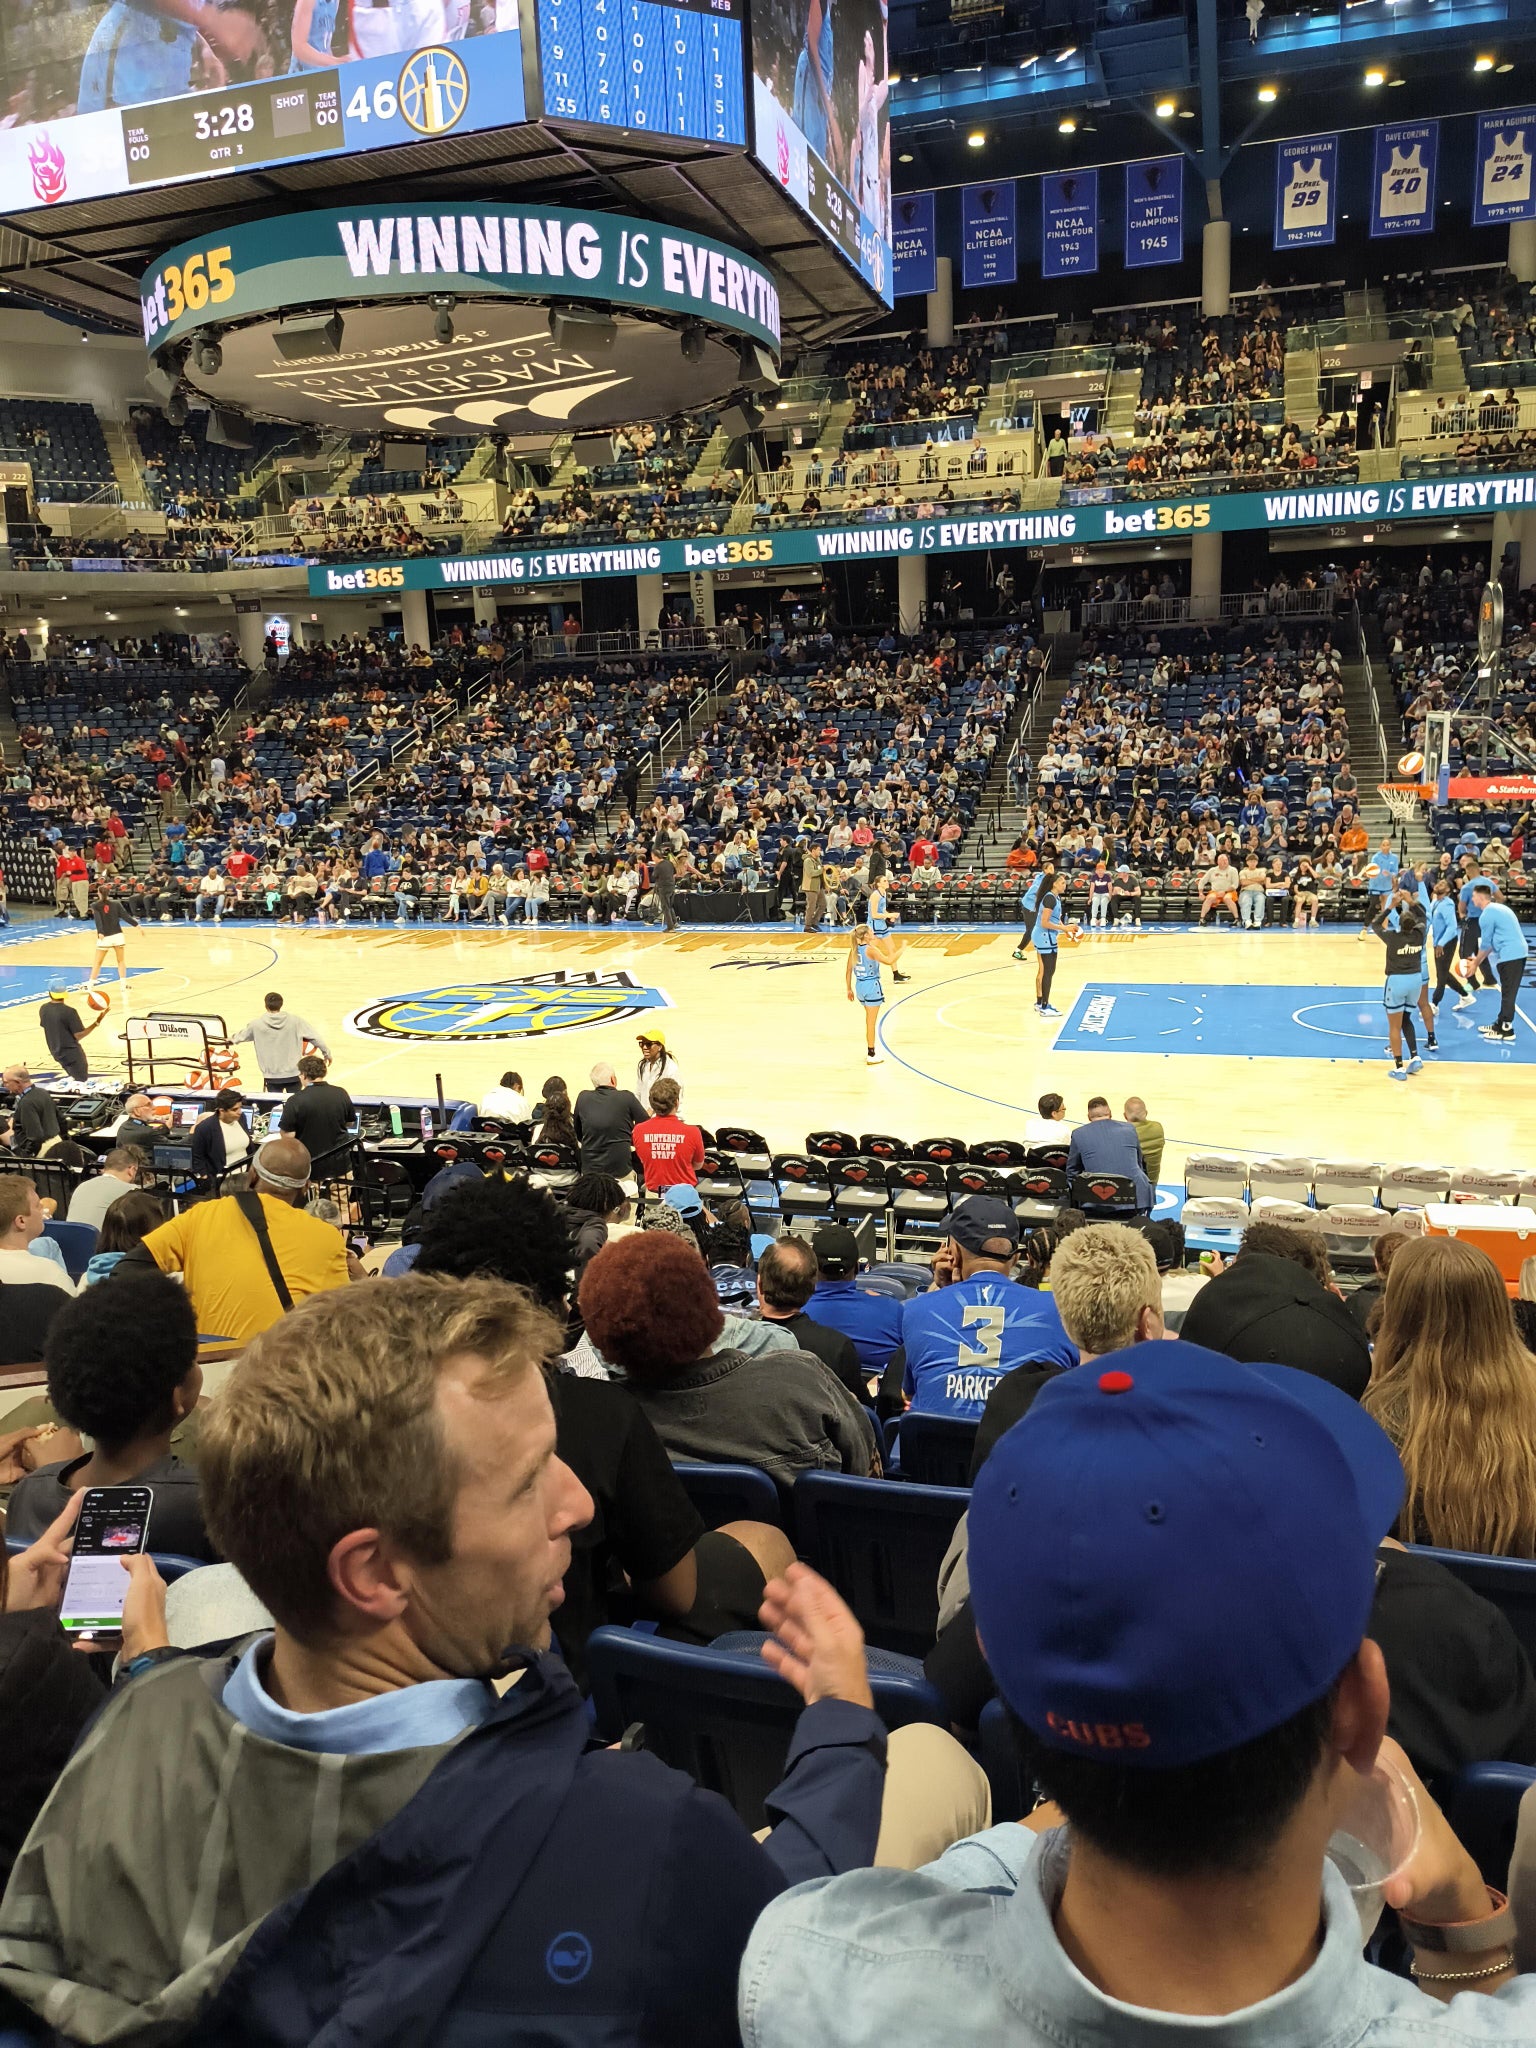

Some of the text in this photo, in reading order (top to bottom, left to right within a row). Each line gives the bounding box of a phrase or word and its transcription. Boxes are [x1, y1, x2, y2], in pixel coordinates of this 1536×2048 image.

[711, 0, 731, 11] REB
[632, 6, 638, 21] 1
[674, 15, 681, 29] 1
[713, 23, 719, 37] 1
[551, 17, 719, 62] 1 0 0 0 1
[553, 46, 723, 89] 9 7 0 1 3
[318, 91, 337, 100] TEAM
[555, 72, 724, 114] 11 2 1 1 5
[276, 94, 305, 109] SHOT
[346, 80, 398, 124] 46
[194, 104, 255, 140] 3:28
[316, 109, 338, 126] 00
[556, 97, 725, 138] 35 6 0 1 2
[1484, 120, 1503, 128] MARK
[1385, 129, 1429, 142] DAVE CORZINE
[130, 145, 150, 161] 00
[210, 144, 244, 160] QTR 3
[1284, 143, 1332, 157] GEORGE MIKAN
[1491, 164, 1524, 182] 24
[1389, 177, 1422, 195] 40
[1291, 190, 1321, 208] 99
[1145, 206, 1164, 217] NIT
[1055, 217, 1084, 229] NCAA
[1130, 215, 1179, 229] CHAMPIONS
[975, 228, 1003, 240] NCAA
[1047, 226, 1094, 239] FINAL FOUR
[861, 232, 872, 266] 46
[896, 239, 923, 251] NCAA
[966, 237, 1013, 250] ELITE EIGHT
[1060, 242, 1080, 251] 1943
[1140, 236, 1168, 250] 1945
[338, 215, 602, 280] WINNING
[617, 231, 649, 288] IS
[892, 250, 918, 260] SWEET
[1060, 256, 1080, 266] 1979
[271, 350, 369, 369] company
[272, 341, 562, 389] ORPORATION
[1324, 358, 1341, 368] 226
[300, 353, 596, 403] MAGELLAN
[1088, 383, 1104, 392] 226
[1264, 489, 1380, 520] WINNING
[1386, 488, 1407, 513] IS
[1105, 503, 1211, 534] bet365
[817, 514, 1076, 556] WINNING IS EVERYTHING
[1330, 523, 1392, 536] 125 126
[684, 539, 774, 566] bet365
[1029, 549, 1044, 559] 124
[441, 548, 661, 583] WINNING IS EVERYTHING
[327, 567, 405, 591] bet365
[717, 570, 765, 581] 123 124
[481, 586, 525, 597] 122 123
[422, 986, 648, 1003] SKY
[158, 1023, 189, 1034] Wilson
[370, 1027, 529, 1041] CHICAGO
[643, 1133, 686, 1143] MONTERREY
[651, 1142, 677, 1151] EVENT
[651, 1150, 676, 1160] STAFF
[958, 1305, 1005, 1368] 3
[946, 1374, 1003, 1401] PARKE
[1046, 1711, 1151, 1748] CUBS
